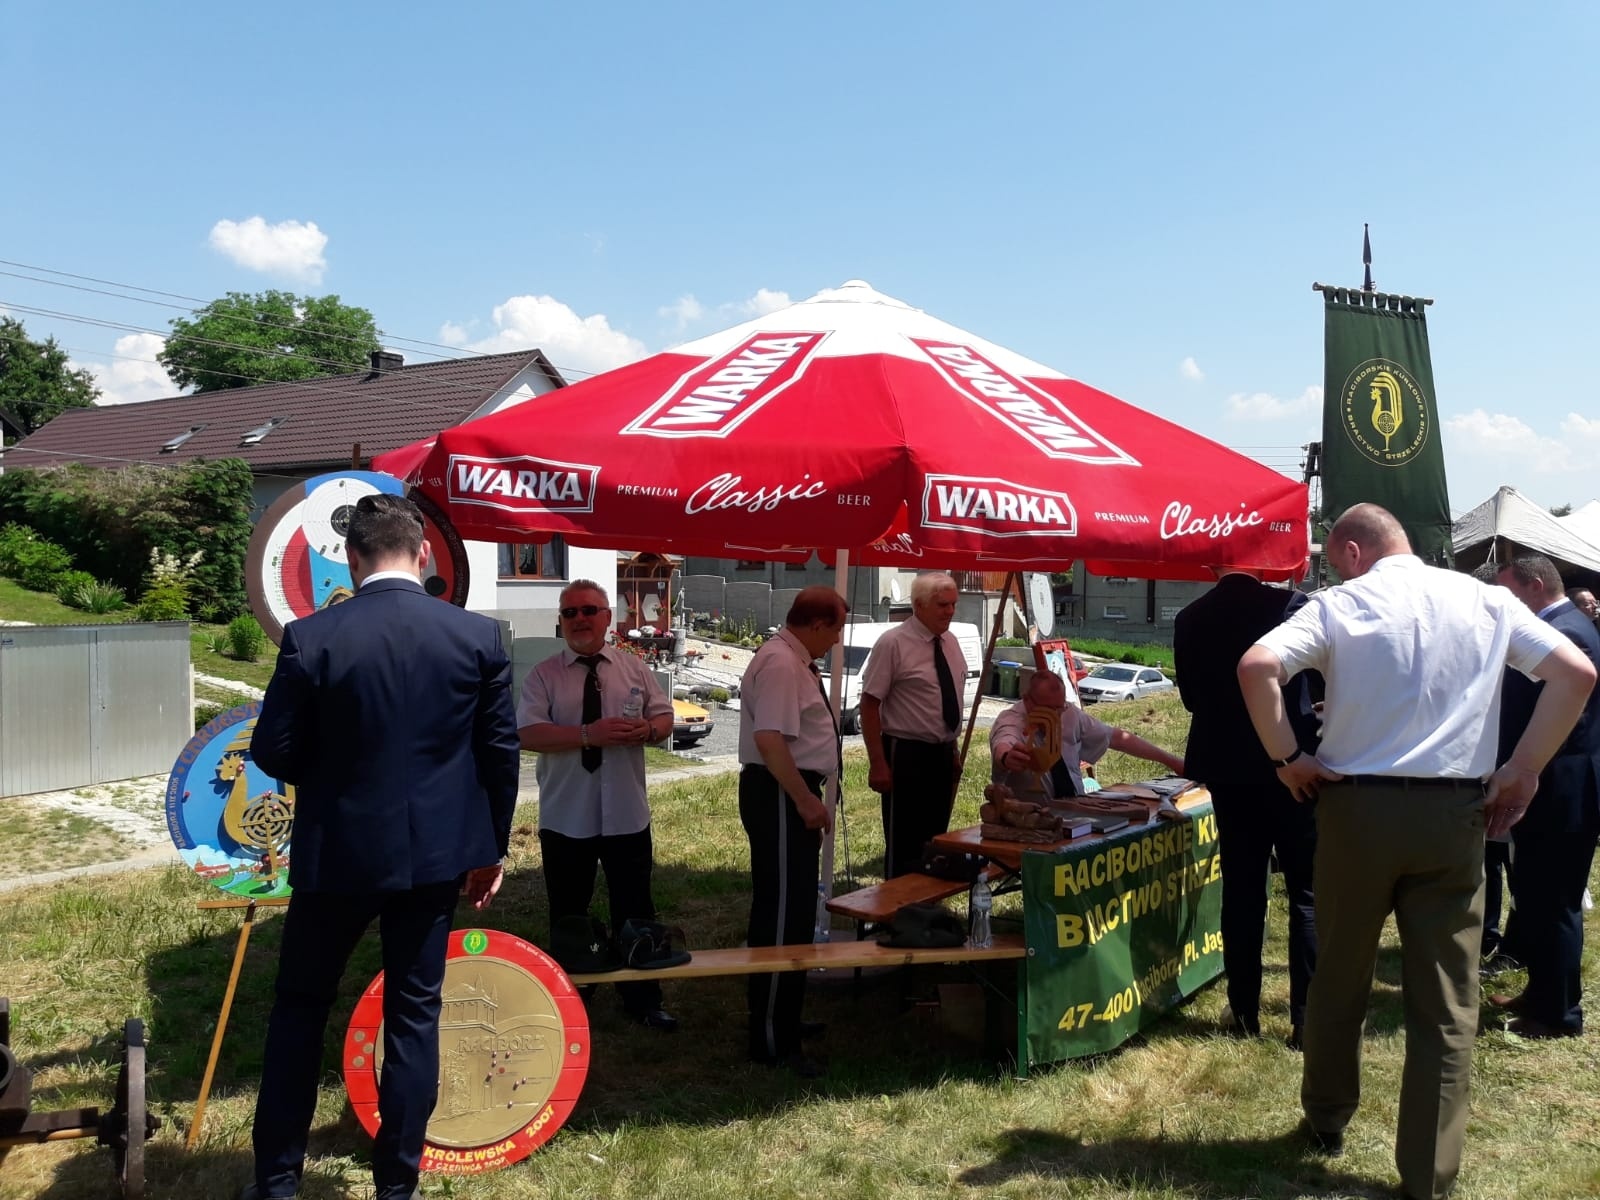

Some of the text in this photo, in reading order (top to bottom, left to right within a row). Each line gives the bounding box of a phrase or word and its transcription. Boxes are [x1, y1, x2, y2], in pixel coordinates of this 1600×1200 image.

[650, 334, 815, 427] WARKA
[925, 346, 1099, 450] WARKA
[1346, 365, 1424, 411] RACIBORSKIE KURKOWE
[1347, 415, 1425, 460] BRACTWO STRZELECKIE
[457, 464, 872, 515] WARKA PREMIUM Classic BEER
[936, 485, 1292, 541] WARKA PREMIUM Classic BEER
[1054, 822, 1194, 897] RACIBORSKIE
[1056, 853, 1224, 948] BRACTWO STRZE
[1058, 987, 1133, 1032] 47-400
[1184, 939, 1200, 966] Pl.
[423, 1103, 556, 1163] KRÓLEWSKA 2007
[435, 1161, 482, 1173] CZERWCA
